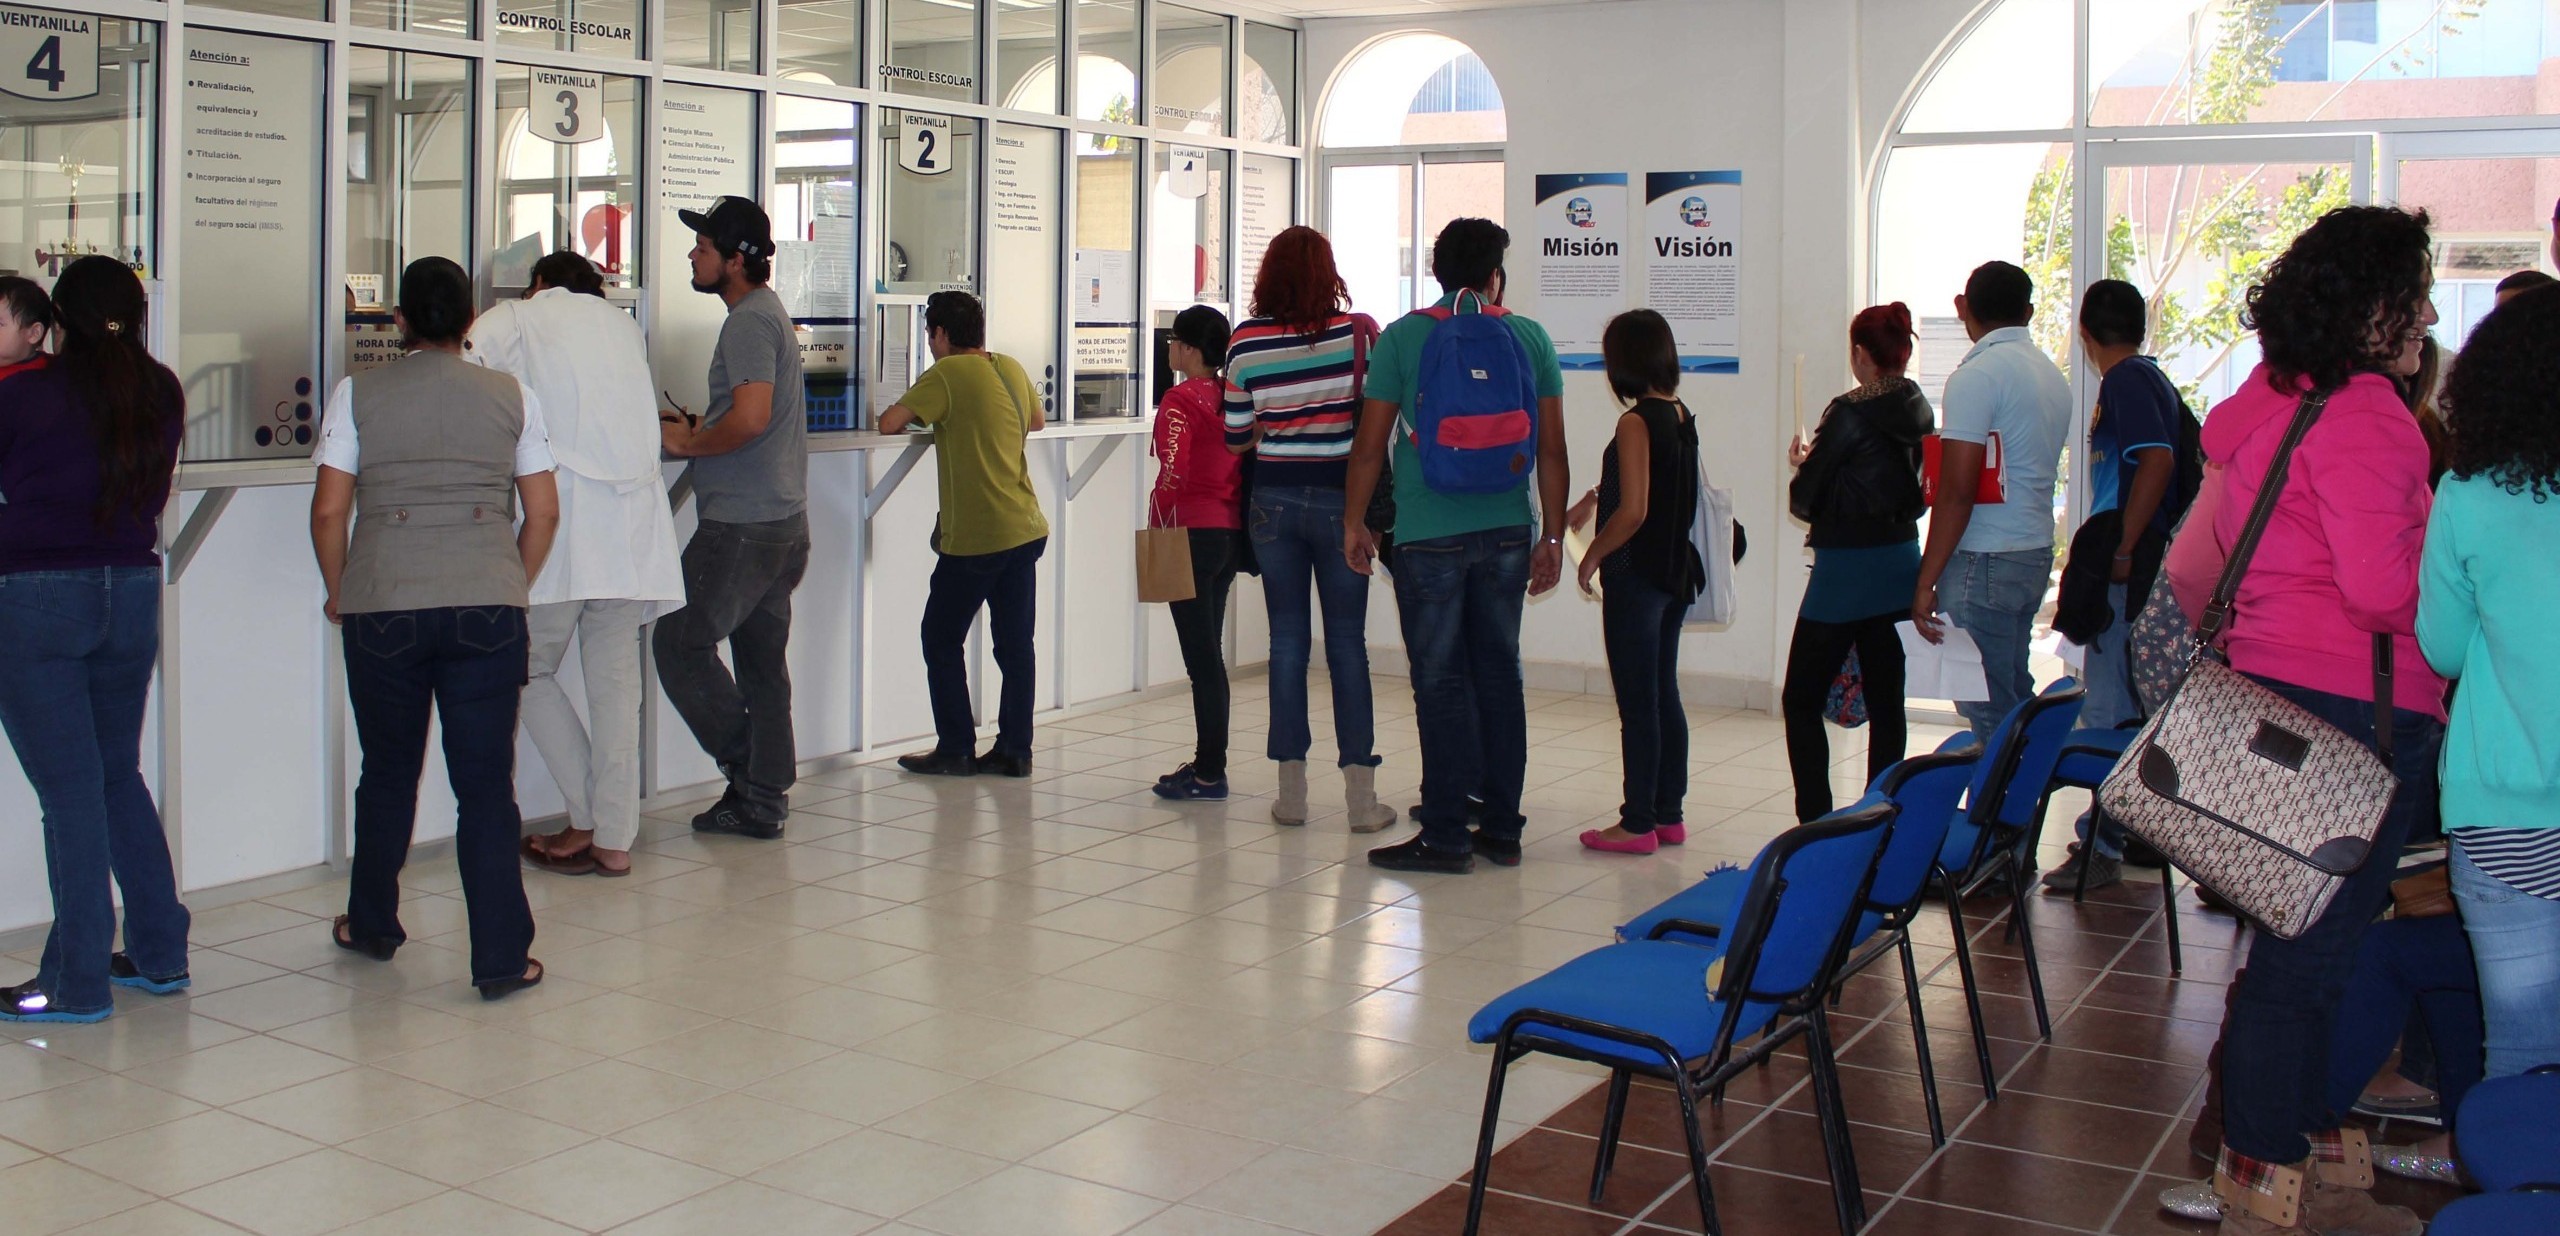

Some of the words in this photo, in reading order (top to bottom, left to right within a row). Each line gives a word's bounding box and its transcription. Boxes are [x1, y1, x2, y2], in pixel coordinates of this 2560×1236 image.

[1, 11, 89, 34] VENTANILLA
[499, 11, 565, 32] CONTROL
[570, 21, 632, 41] ESCOLAR
[26, 35, 65, 92] 4
[189, 49, 237, 63] Atención
[240, 56, 250, 64] a:
[537, 72, 597, 89] VENTANILLA
[878, 64, 926, 82] CONTROL
[928, 71, 972, 88] ESCOLAR
[197, 80, 254, 94] Revalidación,
[196, 104, 251, 116] equivalencia
[663, 99, 697, 110] Atención
[555, 90, 580, 137] 3
[1155, 106, 1188, 119] CONTROL
[905, 114, 947, 129] VENTANILLA
[196, 149, 241, 160] Titulación.
[917, 130, 935, 168] 2
[195, 172, 247, 183] Incorporación
[257, 178, 281, 186] seguro
[195, 196, 234, 206] facultativo
[236, 198, 247, 206] del
[195, 219, 206, 227] del
[208, 220, 234, 229] seguro
[235, 221, 257, 229] social
[1543, 237, 1619, 256] Misión
[1655, 236, 1733, 257] Visión
[356, 339, 384, 348] HORA
[387, 339, 400, 348] DE
[354, 353, 374, 361] 9:05
